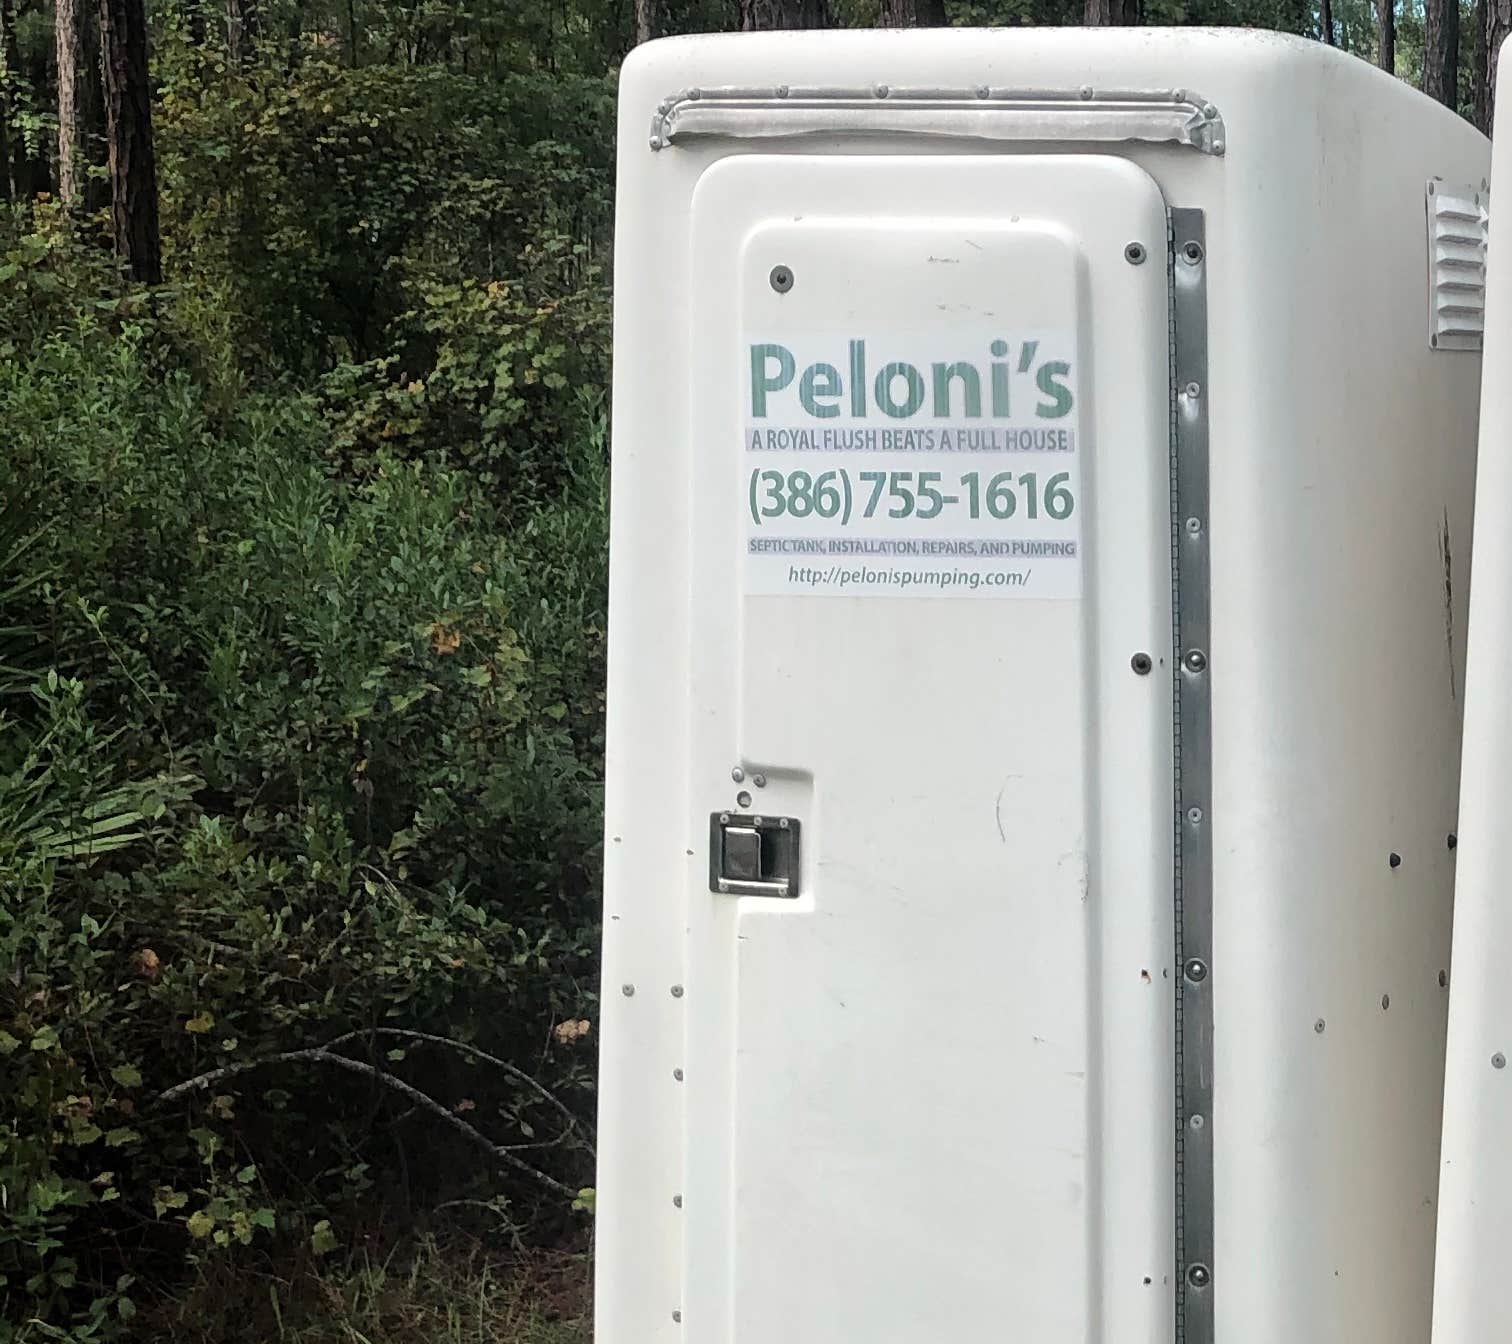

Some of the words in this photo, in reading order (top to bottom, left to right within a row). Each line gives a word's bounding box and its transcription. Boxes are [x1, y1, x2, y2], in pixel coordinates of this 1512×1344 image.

[750, 339, 1074, 419] Peloni's
[751, 430, 763, 450] A
[767, 430, 820, 450] ROYAL
[823, 430, 877, 450] FLUSH
[881, 430, 935, 450] BEATS
[940, 430, 951, 450] A
[957, 430, 1001, 450] FULL
[1005, 430, 1068, 451] HOUSE
[749, 468, 853, 526] (386)
[859, 470, 1075, 520] 755-1616
[828, 540, 919, 555] INSTALLATION,
[922, 541, 978, 556] REPAIRS,
[980, 542, 1010, 555] AND
[1012, 542, 1075, 556] PUMPING
[788, 564, 1032, 590] http://pelonispumping.com/
